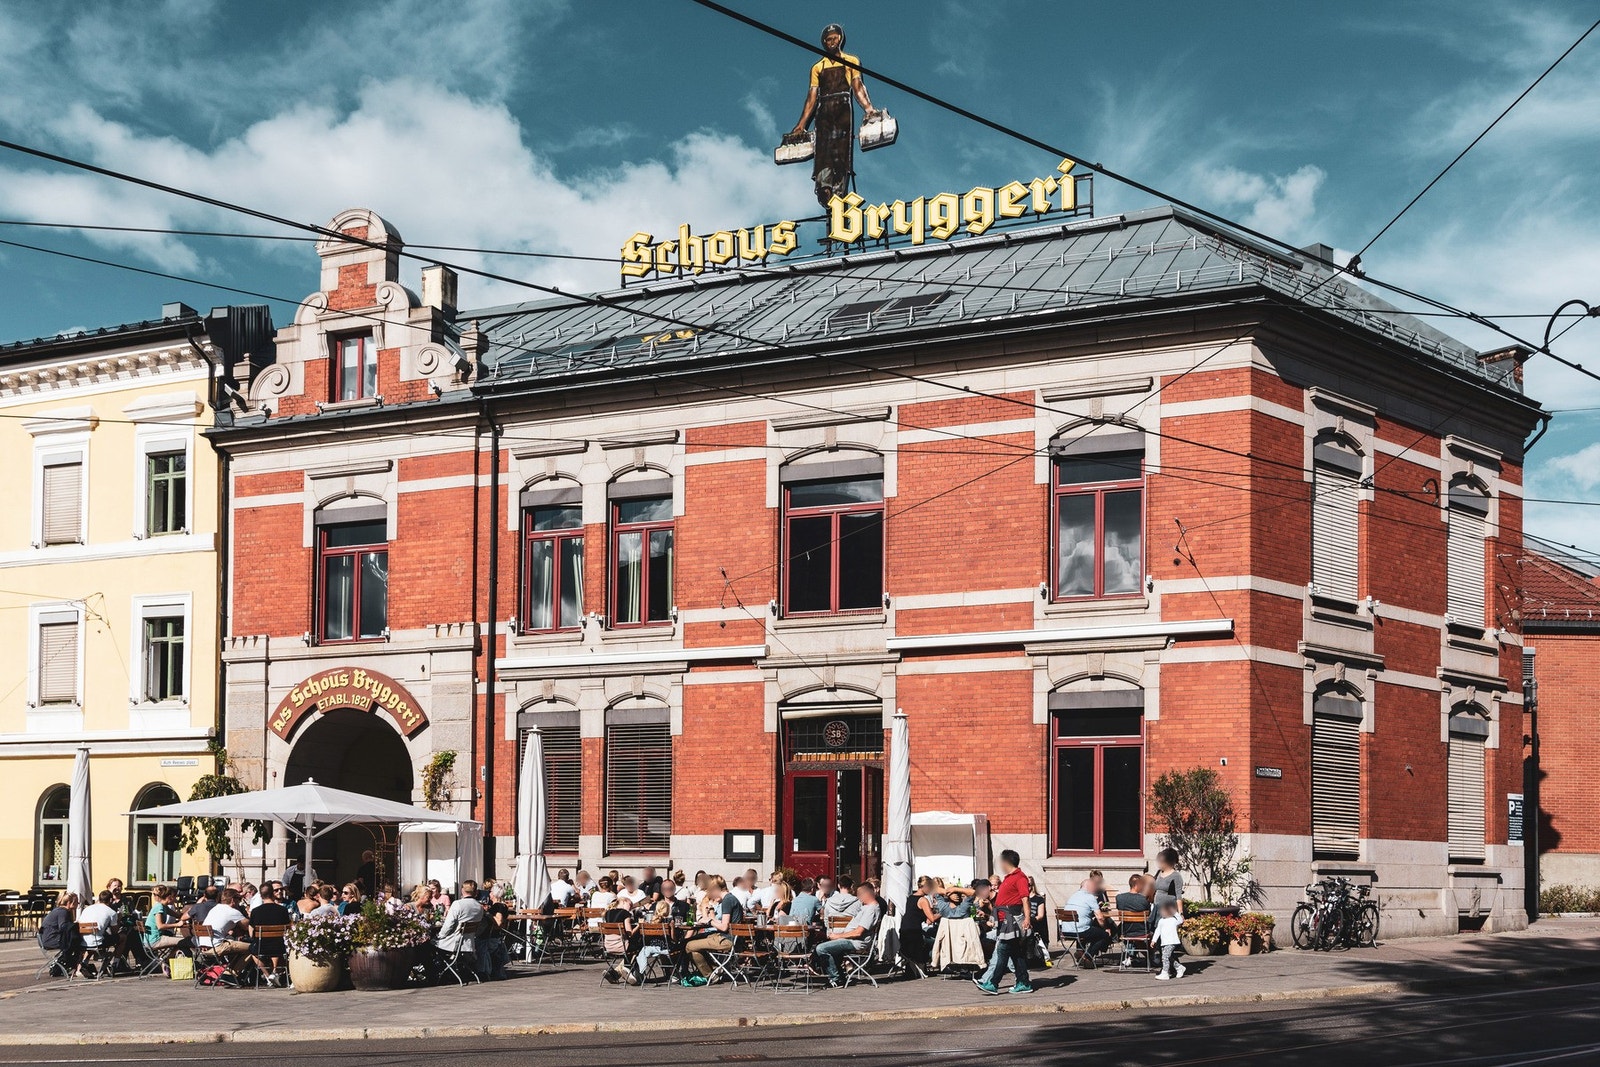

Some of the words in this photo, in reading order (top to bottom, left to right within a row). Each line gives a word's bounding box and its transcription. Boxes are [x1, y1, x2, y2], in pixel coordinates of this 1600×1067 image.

[620, 220, 799, 277] Schous
[827, 157, 1077, 246] Bryggeri
[290, 672, 349, 708] Schous
[351, 668, 421, 727] Bryggeri
[1508, 800, 1516, 815] P
